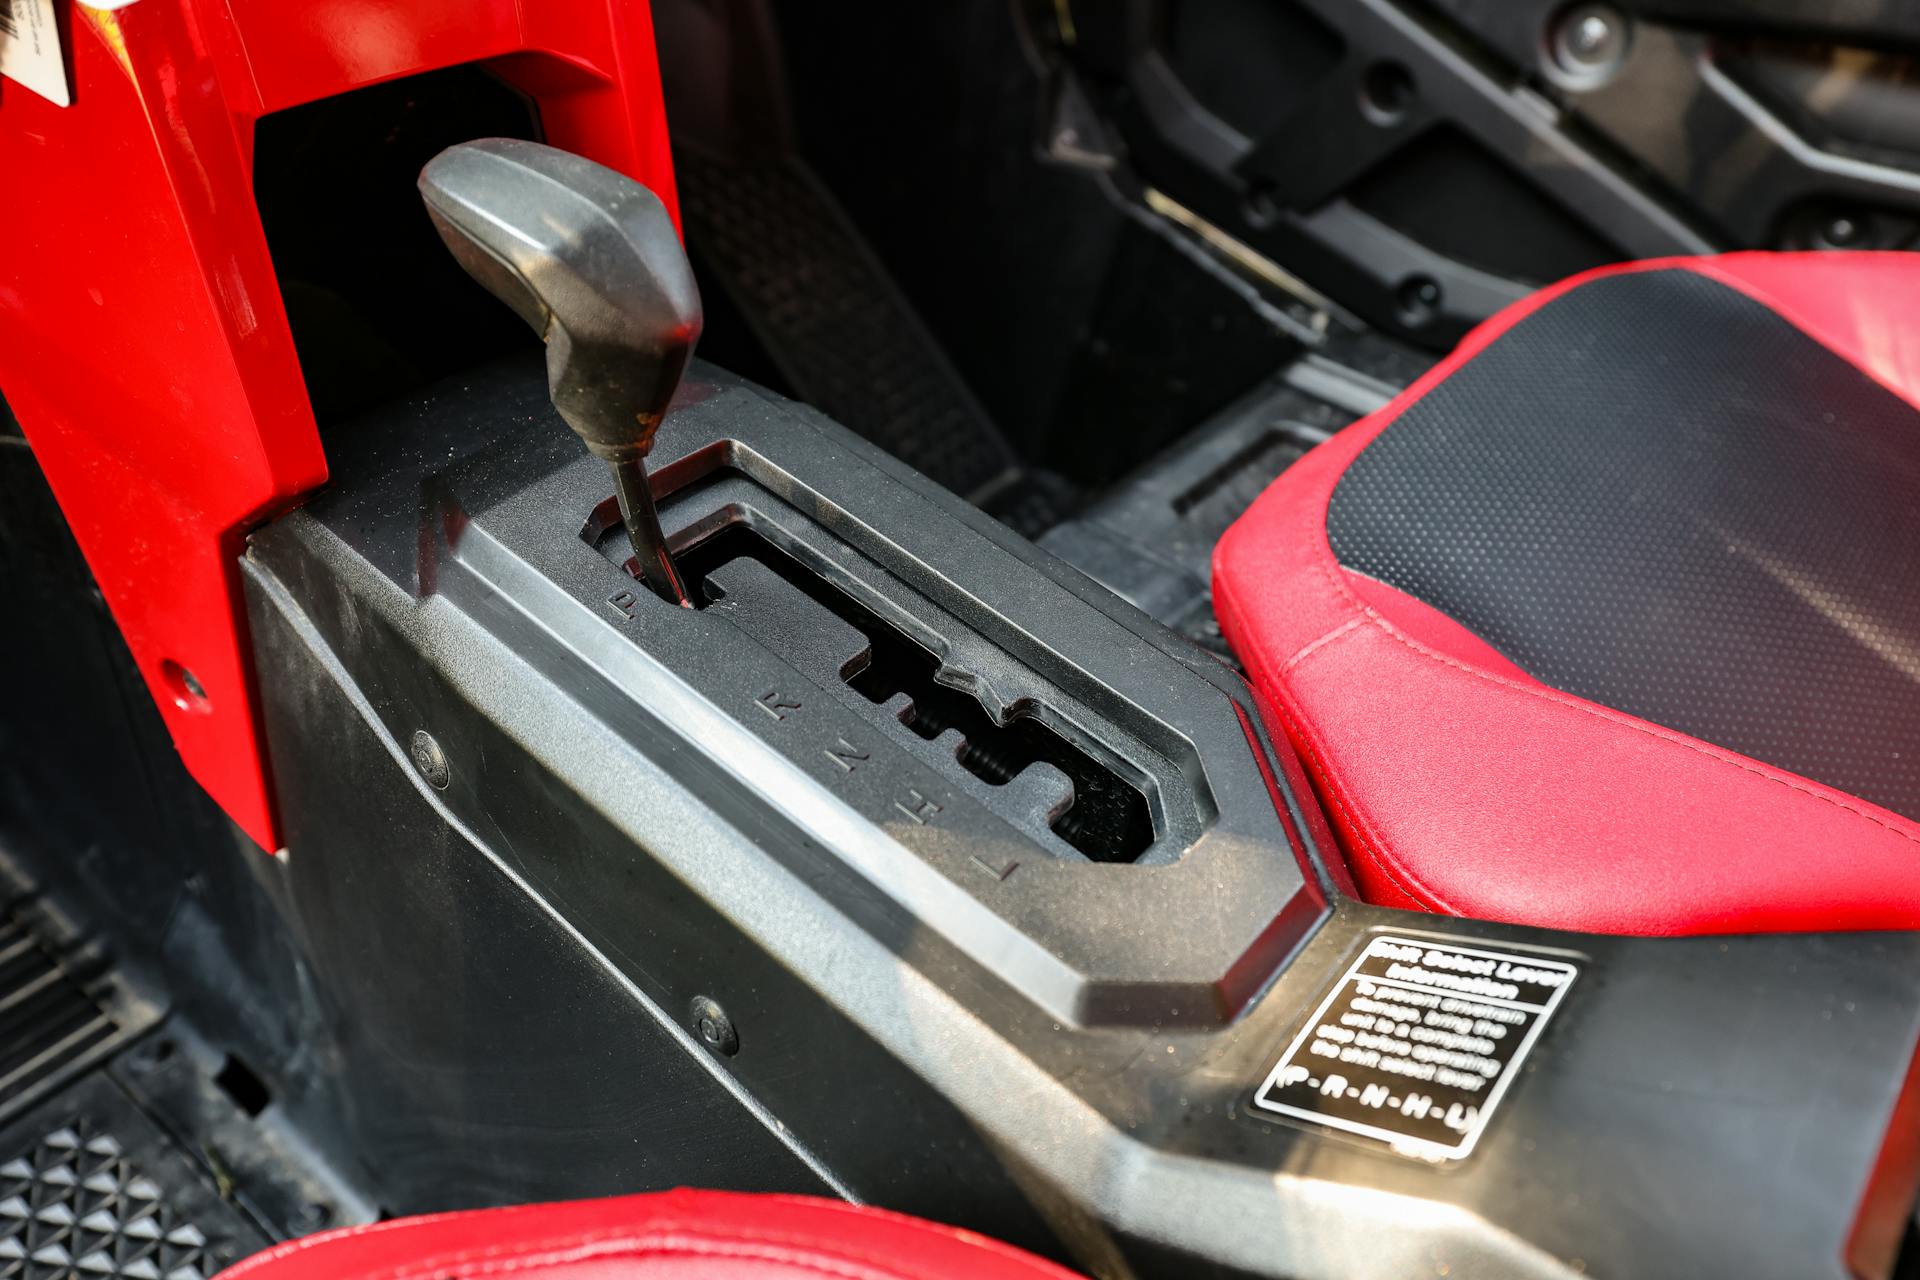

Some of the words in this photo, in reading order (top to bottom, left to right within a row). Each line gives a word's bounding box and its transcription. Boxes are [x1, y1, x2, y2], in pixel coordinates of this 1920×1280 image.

[606, 590, 637, 621] P
[753, 690, 802, 722] R
[823, 737, 871, 773] N
[894, 789, 944, 826] H
[968, 855, 1020, 882] L
[1386, 962, 1518, 999] Information
[1496, 961, 1567, 987] Lever
